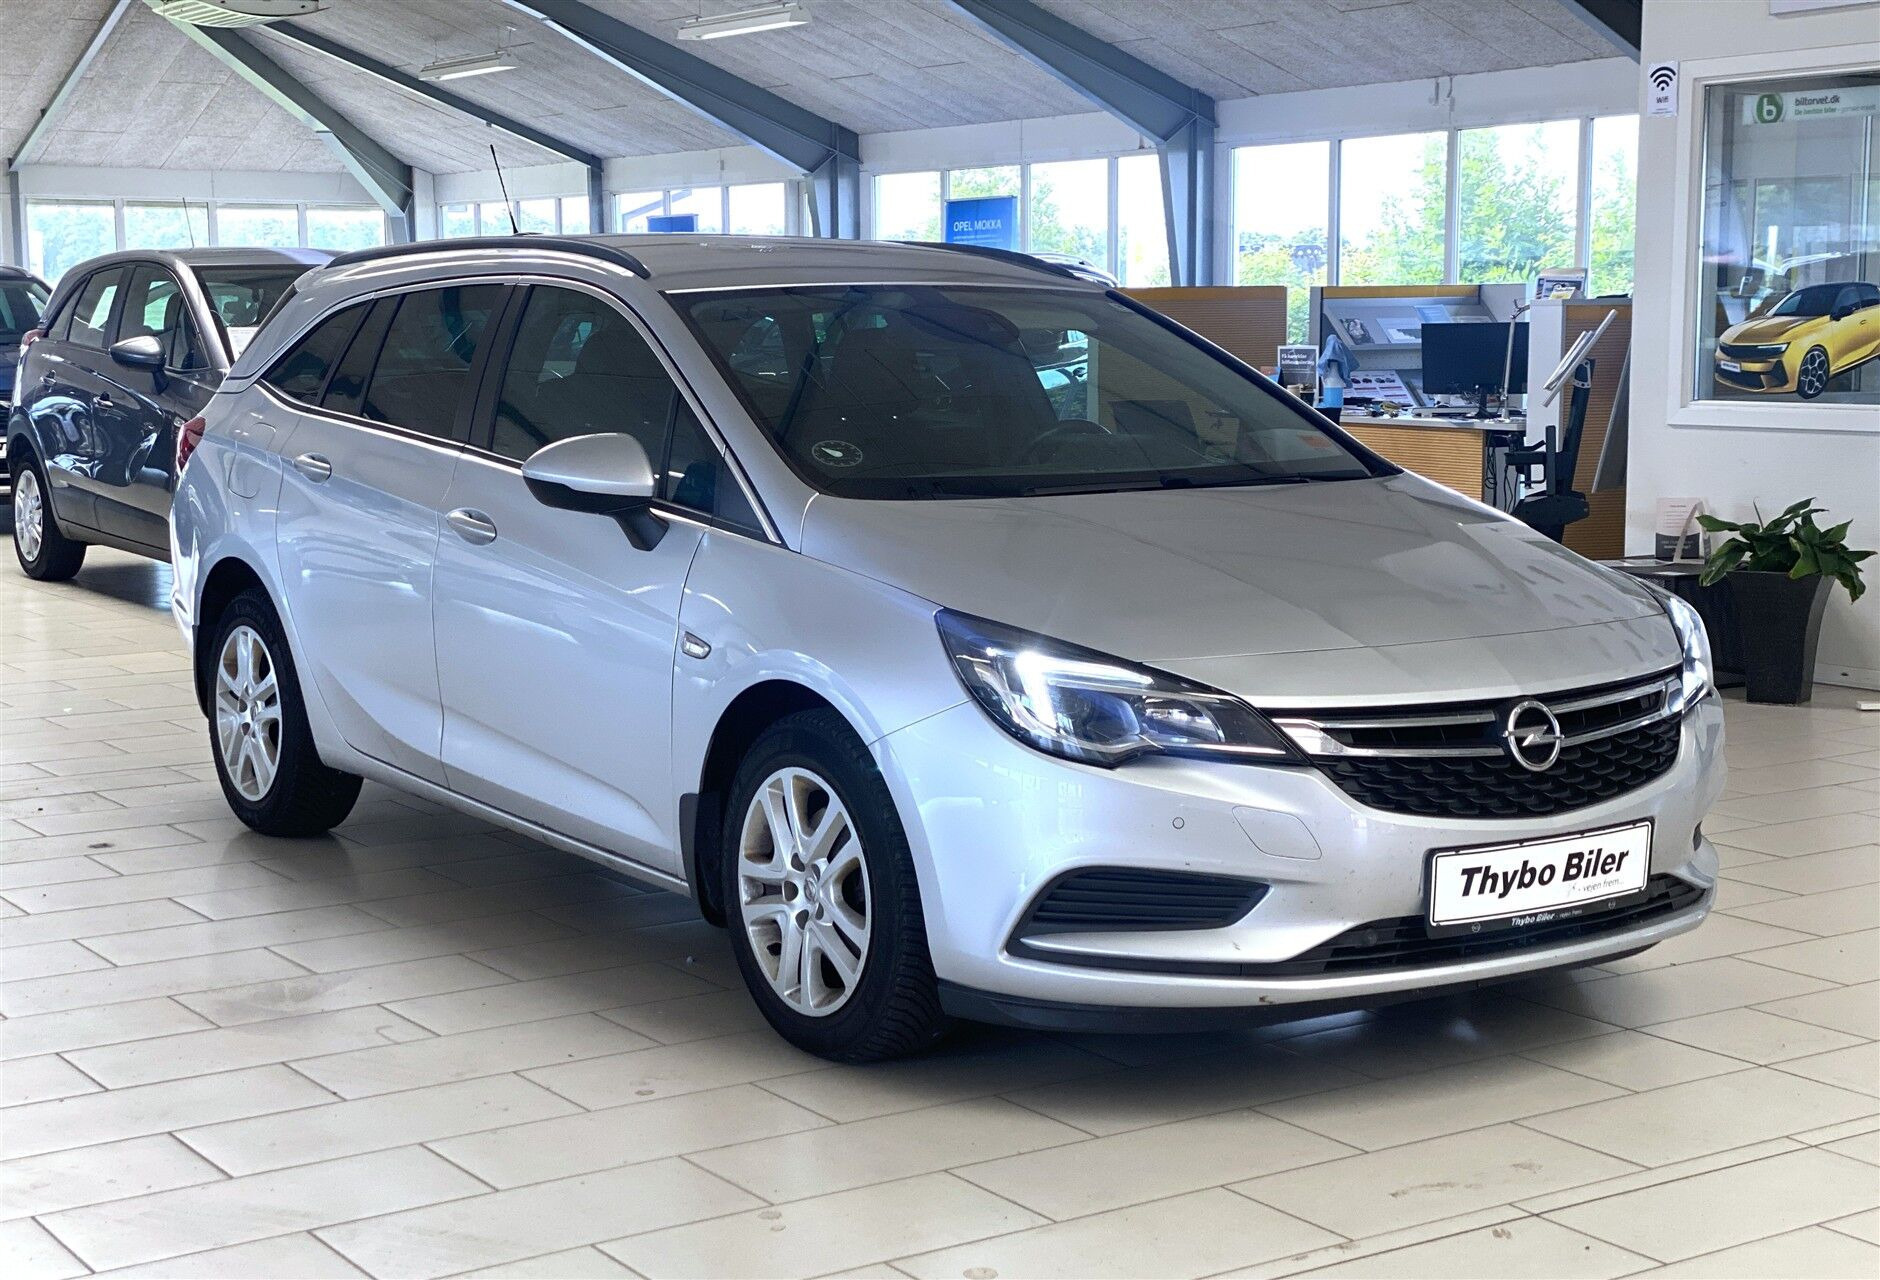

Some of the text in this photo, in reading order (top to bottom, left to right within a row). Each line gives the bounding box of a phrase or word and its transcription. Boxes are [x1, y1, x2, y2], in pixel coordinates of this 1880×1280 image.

[953, 219, 1002, 232] OPEL MOKKA
[1461, 848, 1630, 900] Thybo Biler
[1511, 915, 1536, 927] Thybo
[1536, 912, 1556, 922] Biler
